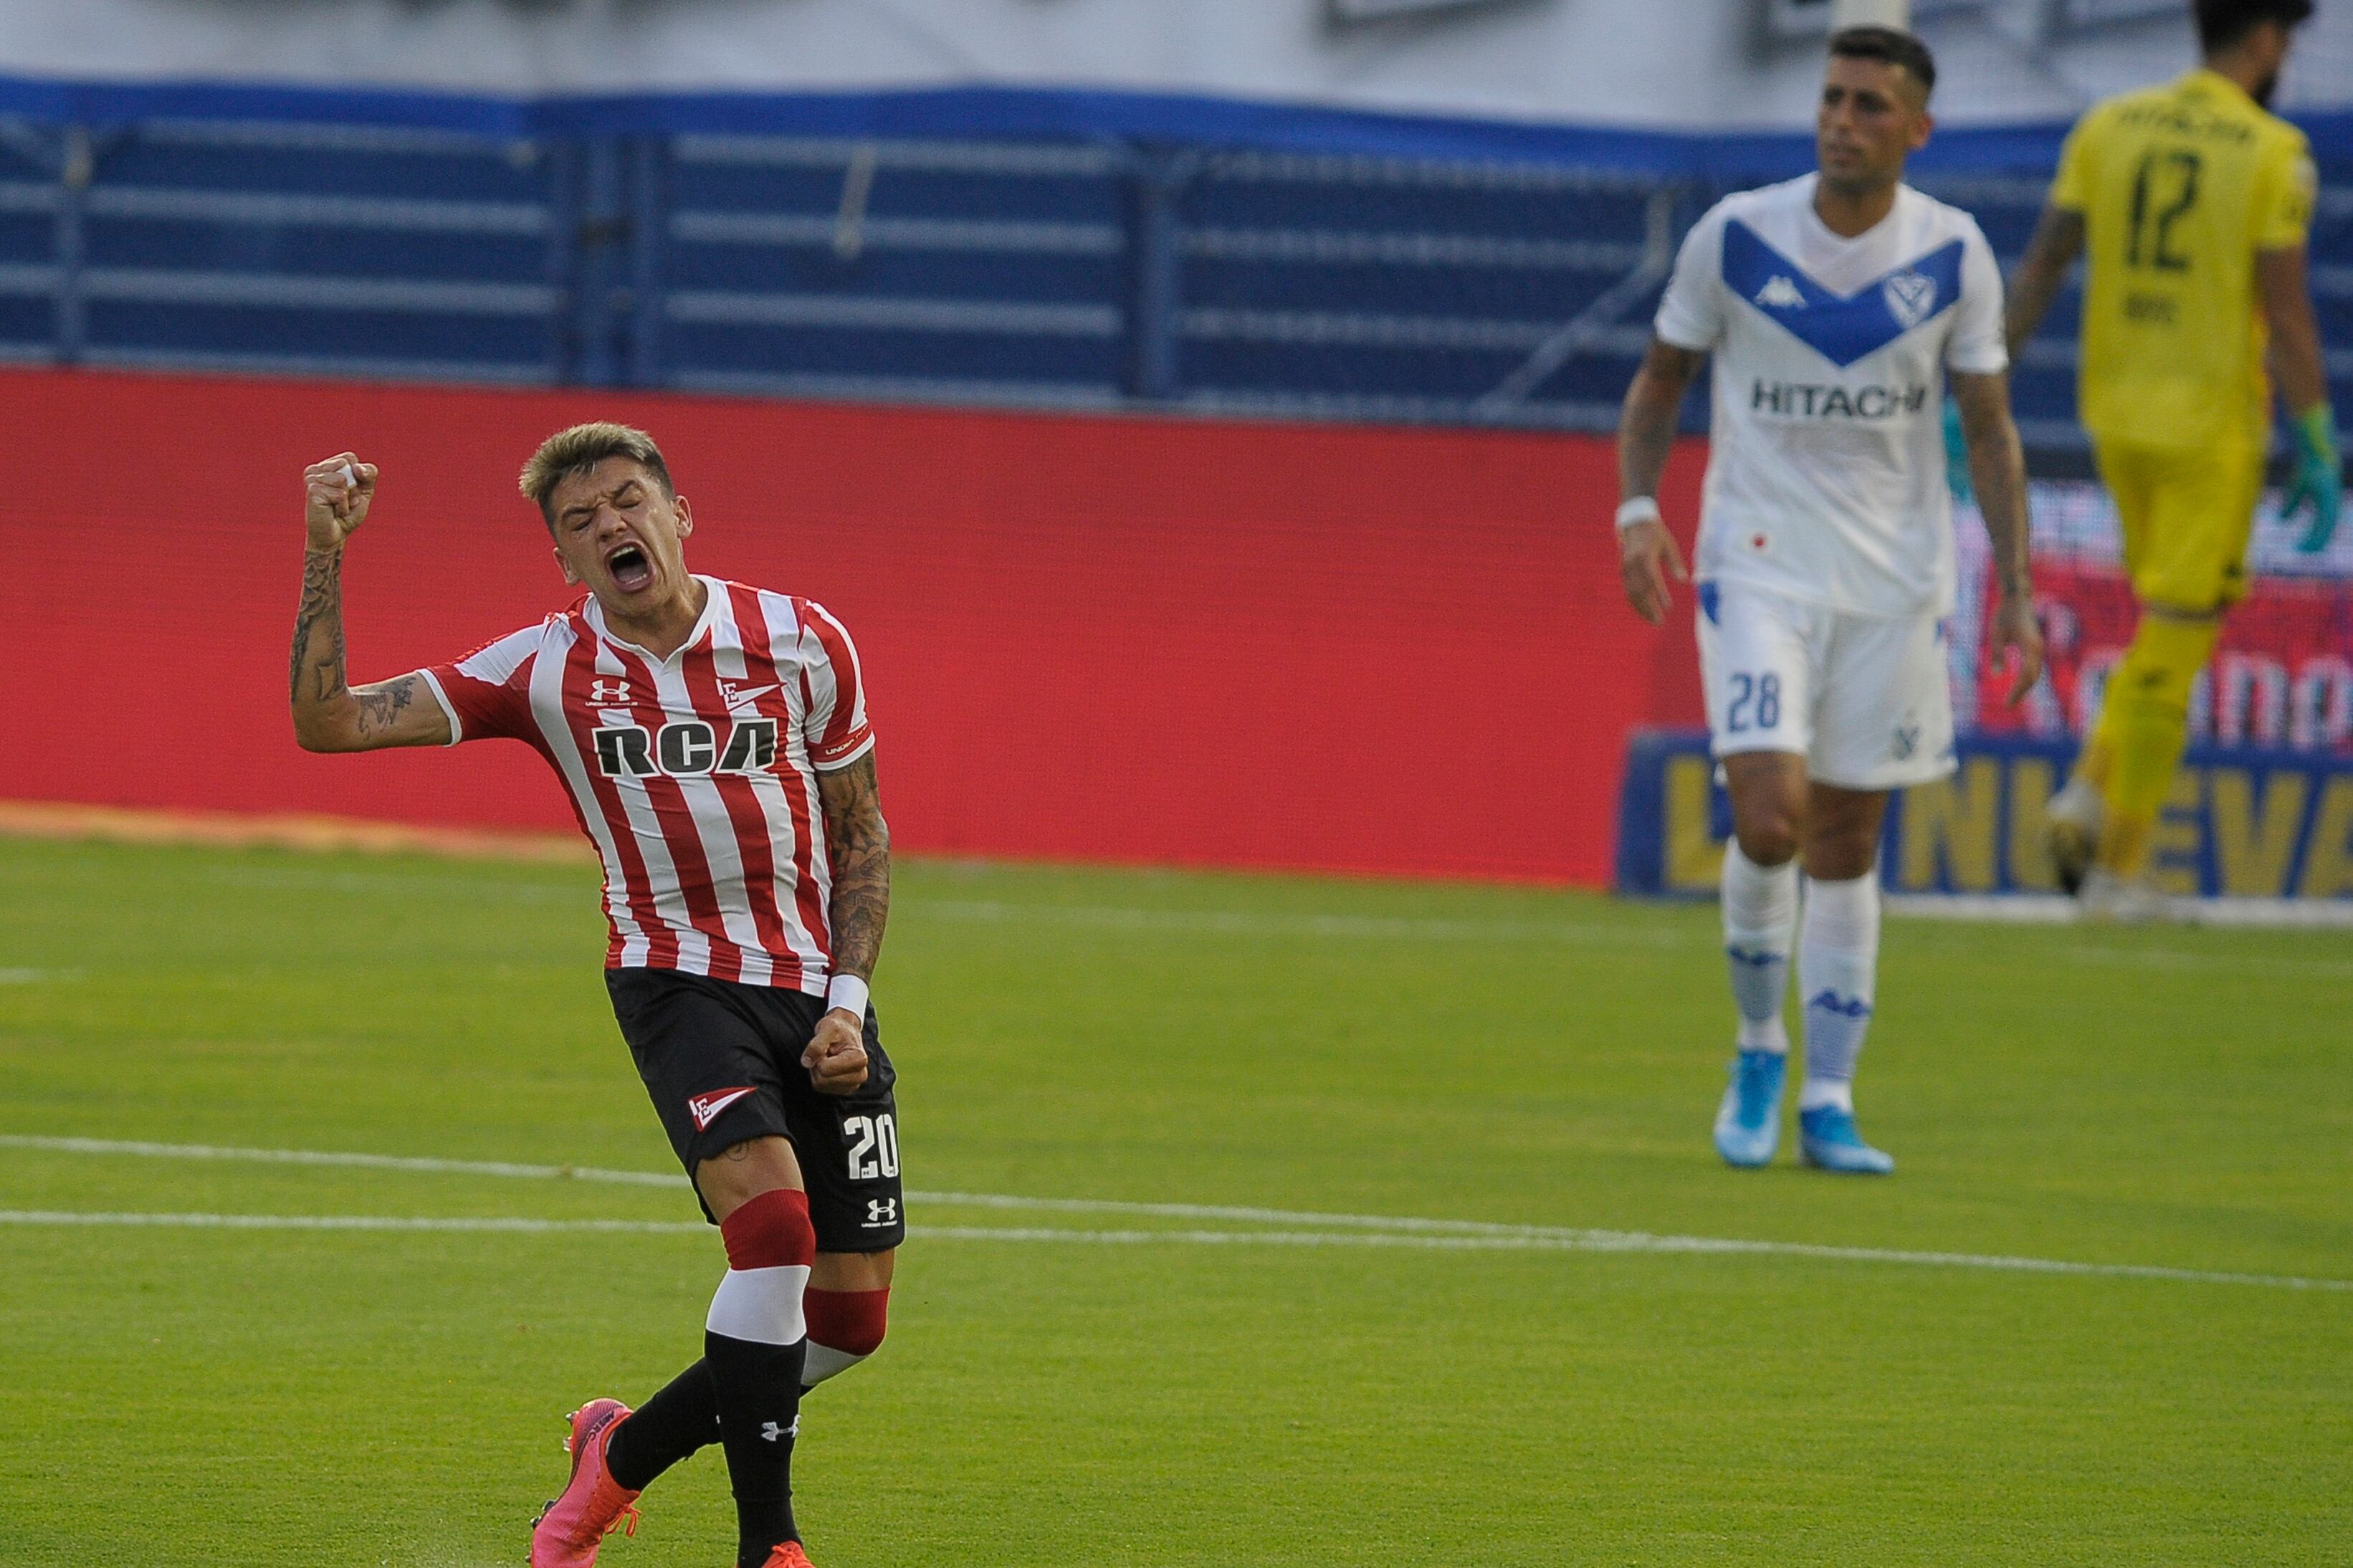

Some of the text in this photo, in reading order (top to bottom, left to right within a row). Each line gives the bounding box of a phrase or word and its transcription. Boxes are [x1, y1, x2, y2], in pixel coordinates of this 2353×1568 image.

[2124, 146, 2201, 272] 12
[1728, 672, 1780, 732] 28
[591, 718, 778, 778] RCA
[844, 1114, 899, 1180] 20
